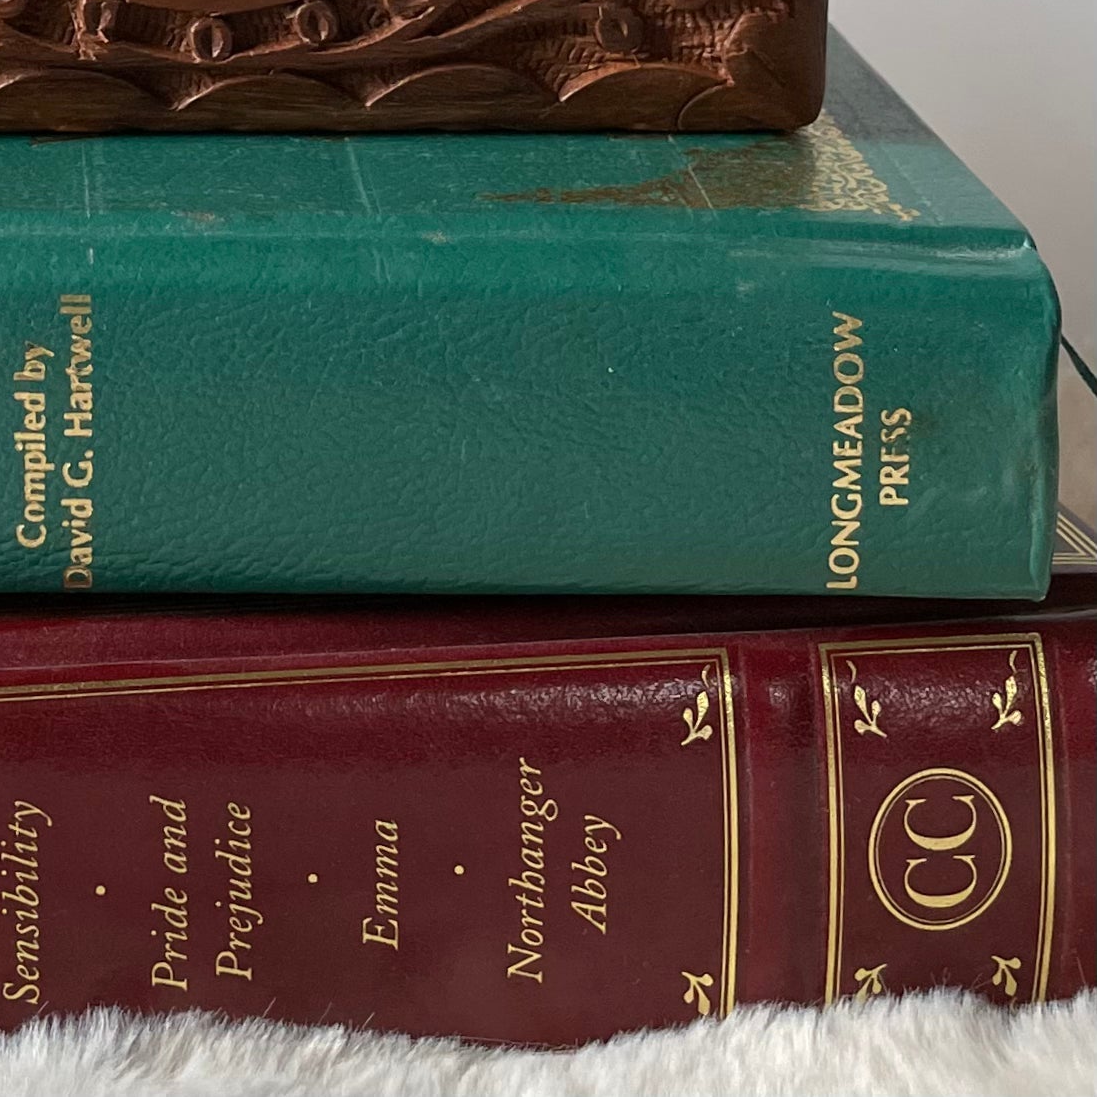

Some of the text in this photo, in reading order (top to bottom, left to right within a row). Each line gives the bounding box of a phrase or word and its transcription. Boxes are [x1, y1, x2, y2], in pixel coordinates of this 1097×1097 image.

[13, 340, 55, 548] Compiled by
[58, 294, 94, 590] David G. Hartwell
[826, 310, 865, 589] LONGMEADOW
[879, 407, 913, 506] PRESS
[0, 800, 53, 1004] Sensibility
[149, 795, 189, 993] Pride and
[214, 801, 264, 982] Prejudice
[362, 819, 399, 952] Emma
[506, 757, 559, 984] Northanger
[570, 815, 622, 935] Abbey
[903, 794, 978, 908] CC
